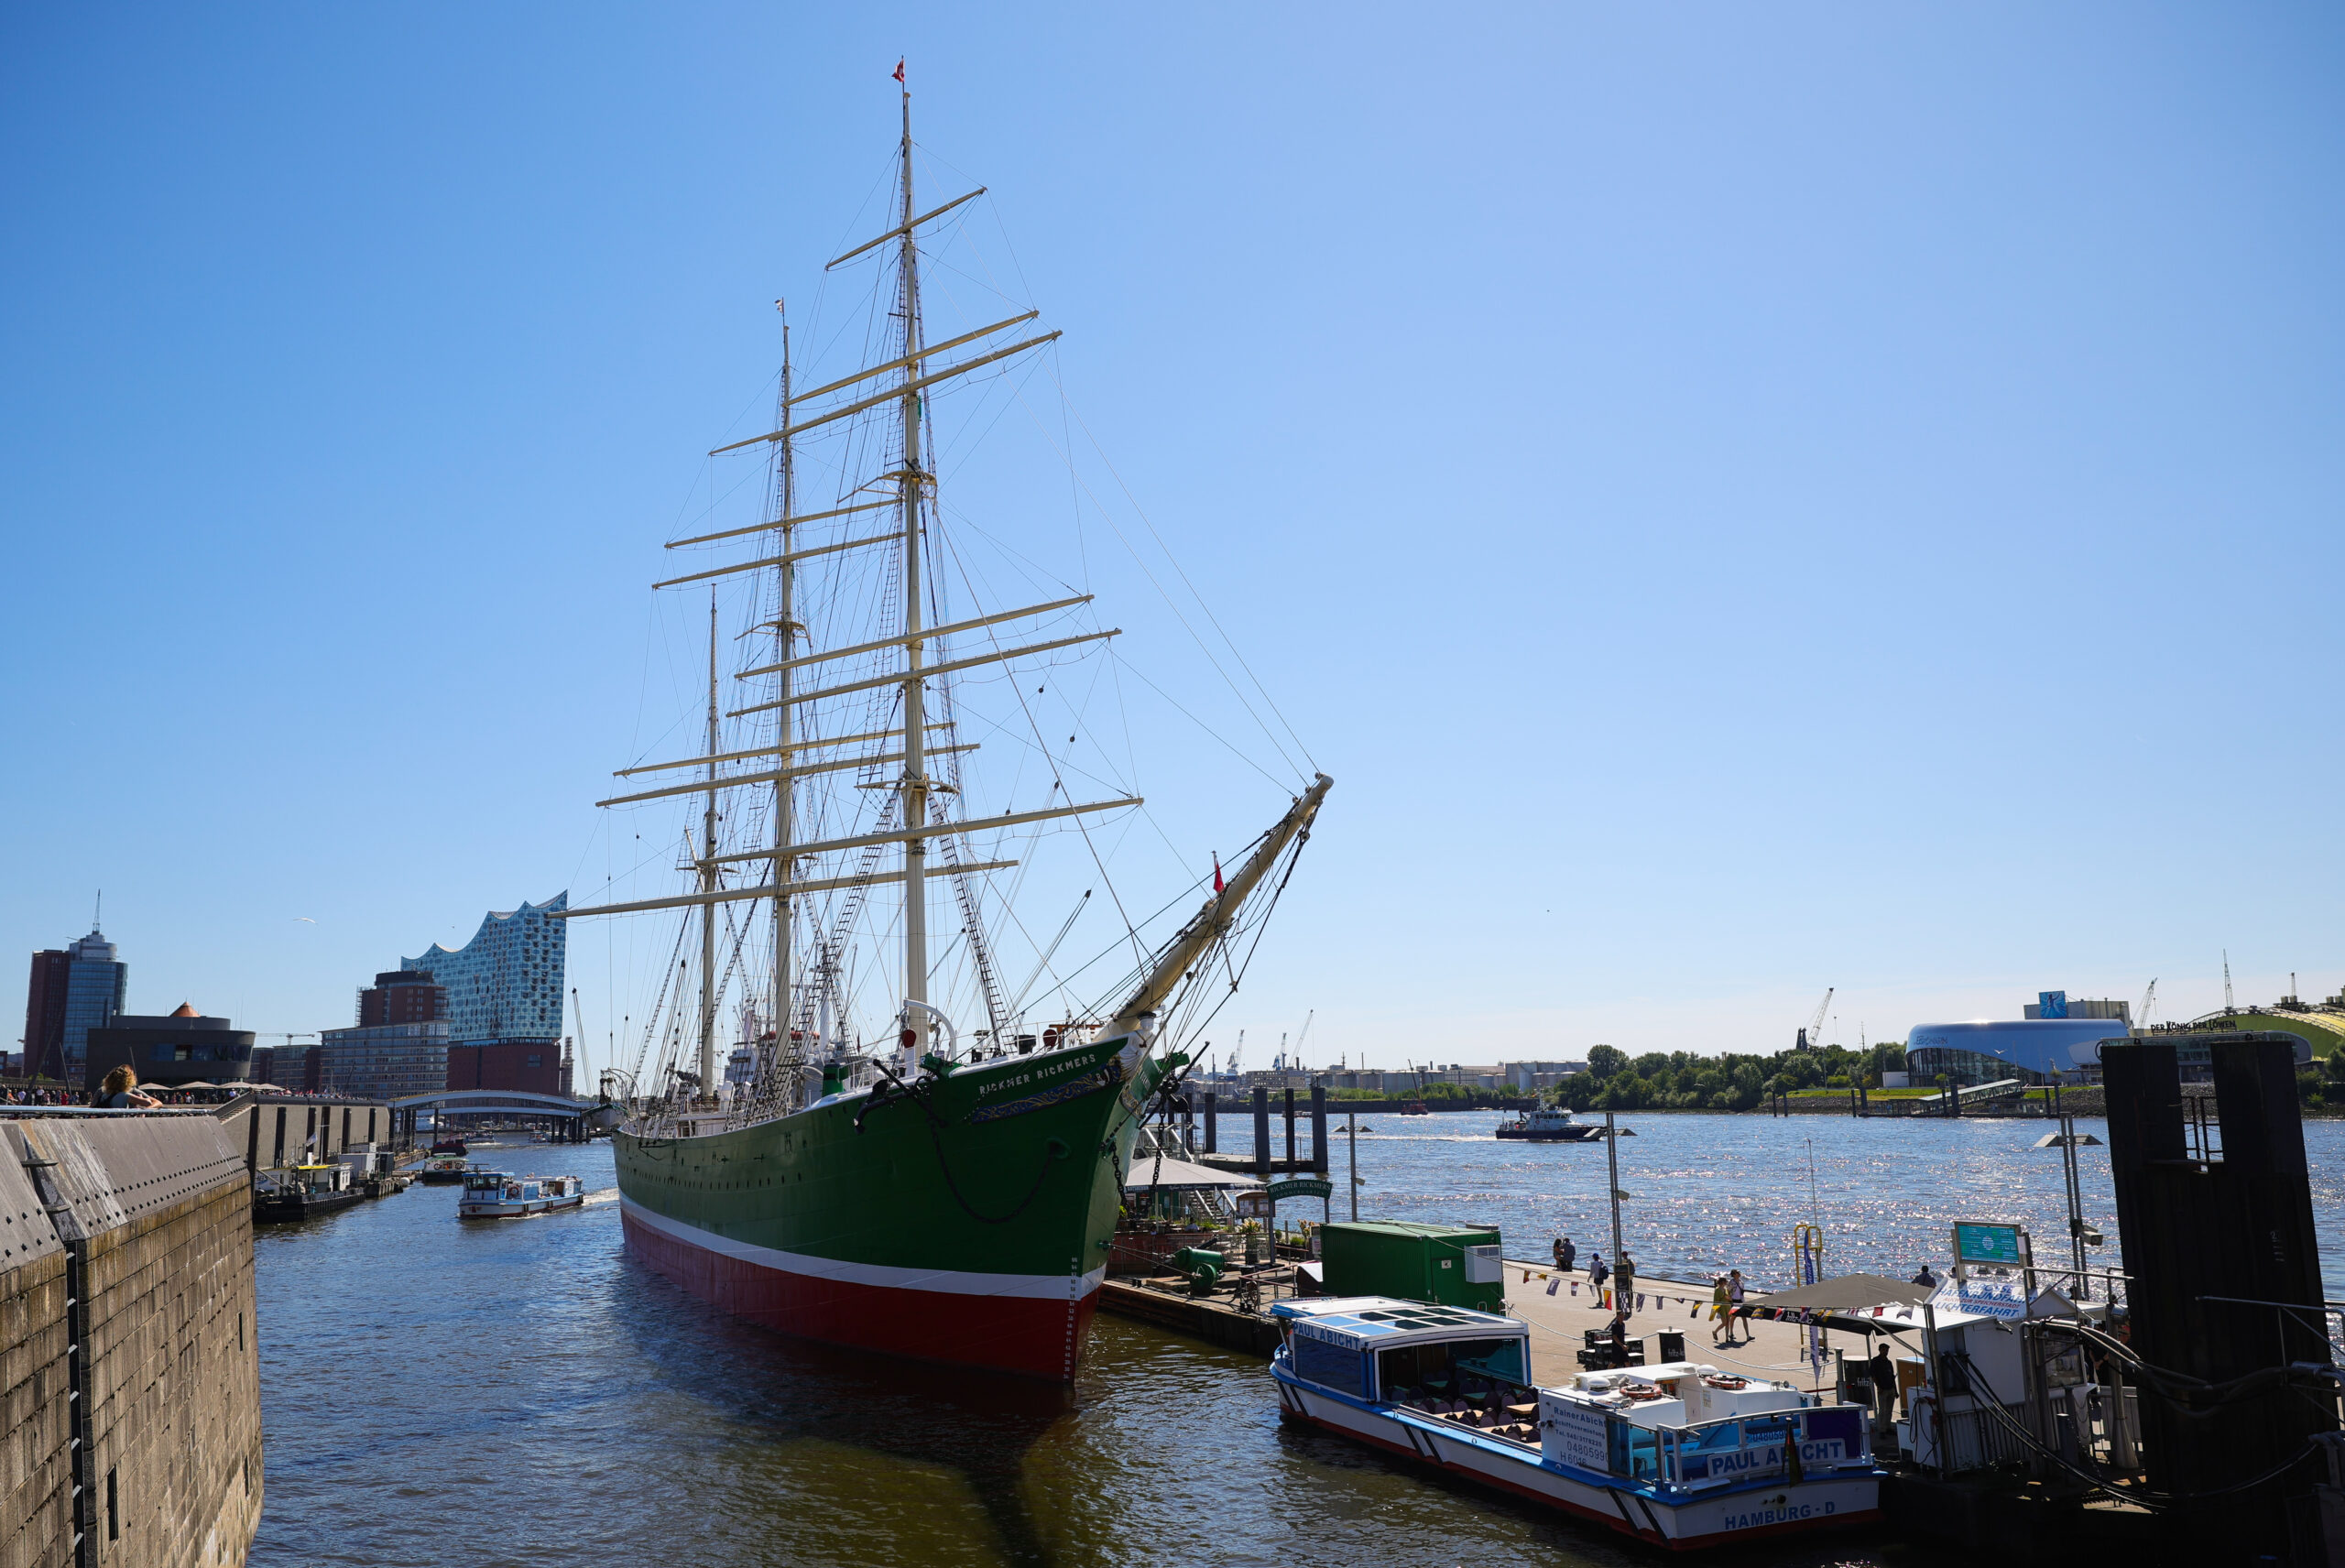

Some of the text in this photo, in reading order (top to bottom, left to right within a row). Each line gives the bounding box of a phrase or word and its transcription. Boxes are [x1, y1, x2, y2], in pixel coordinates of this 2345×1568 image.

[979, 1053, 1096, 1095] RICKMER RICKMERS
[1271, 1181, 1331, 1193] RICKMER RICKMERS
[1935, 1301, 2019, 1317] LICHTERFAHRT
[1293, 1322, 1360, 1350] PAUL ABICHT
[1554, 1407, 1579, 1420] Rainer
[1711, 1452, 1760, 1475] PAUL
[1725, 1504, 1811, 1530] HAMBURG
[1825, 1501, 1836, 1514] D
